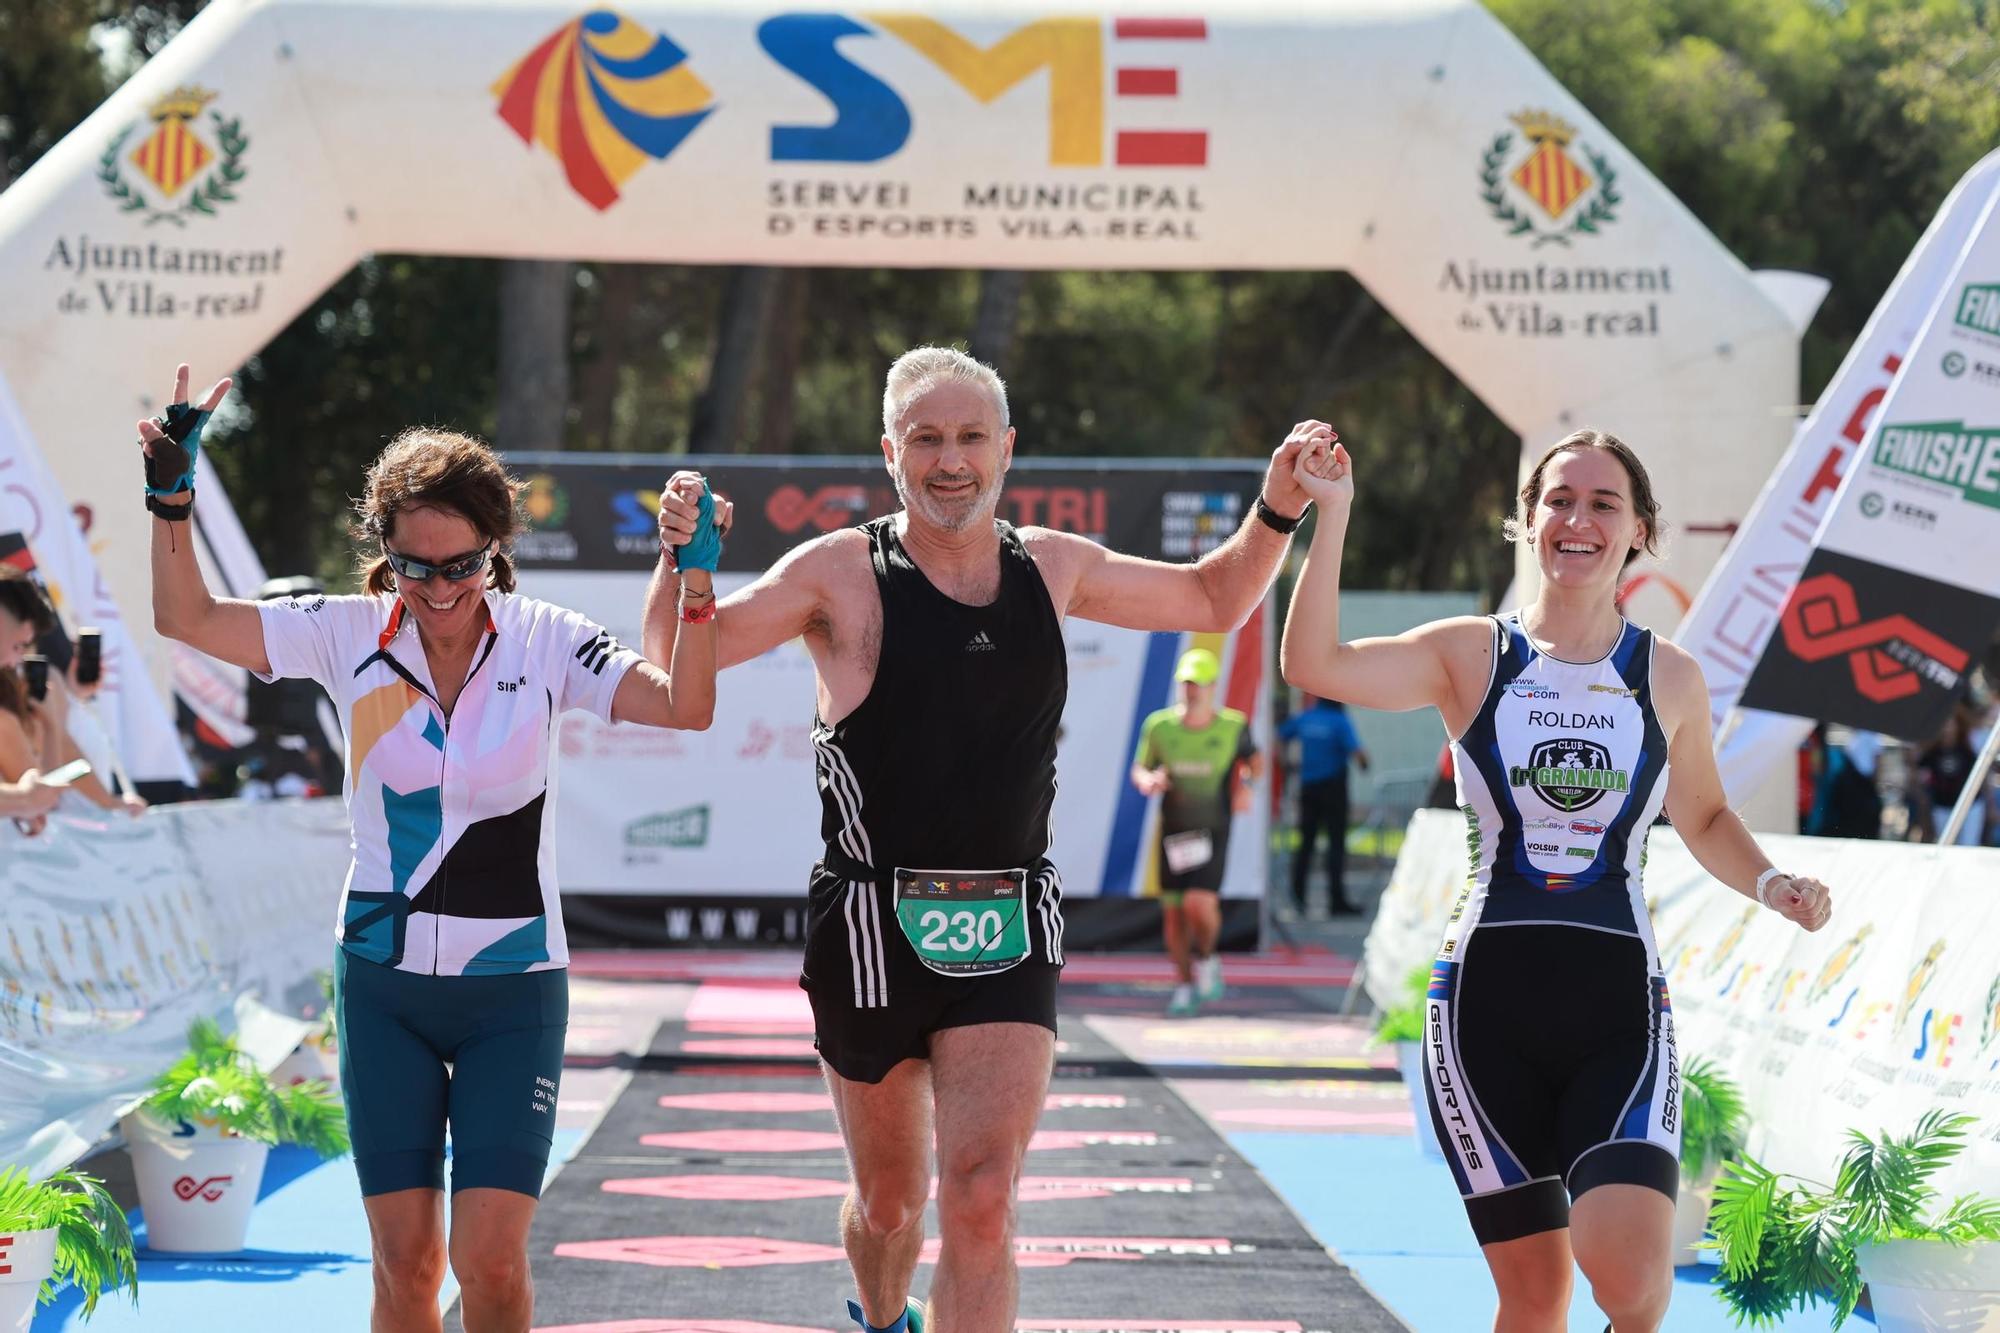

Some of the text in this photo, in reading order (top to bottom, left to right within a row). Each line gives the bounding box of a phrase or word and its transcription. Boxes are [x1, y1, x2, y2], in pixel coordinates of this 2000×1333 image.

[757, 12, 1209, 168] SME
[768, 182, 1204, 212] SERVEI MUNICIPAL
[999, 216, 1199, 240] VILA-REAL
[45, 236, 284, 276] Ajuntament
[1439, 260, 1672, 299] Ajuntament
[58, 282, 264, 318] de Vila-real
[1458, 302, 1659, 338] de Vila-real
[1876, 428, 2000, 492] FINISHE
[1528, 710, 1614, 729] ROLDAN
[1557, 741, 1584, 751] CLUB
[1510, 765, 1630, 795] triGRANADA
[1527, 842, 1560, 853] VOLSUR
[994, 887, 1013, 896] SPRINT
[920, 910, 1003, 952] 230
[1911, 1007, 1964, 1069] SME
[534, 1089, 556, 1105] ON THE
[536, 1076, 556, 1091] INBIKE
[1431, 1003, 1483, 1171] GSPORT.ES
